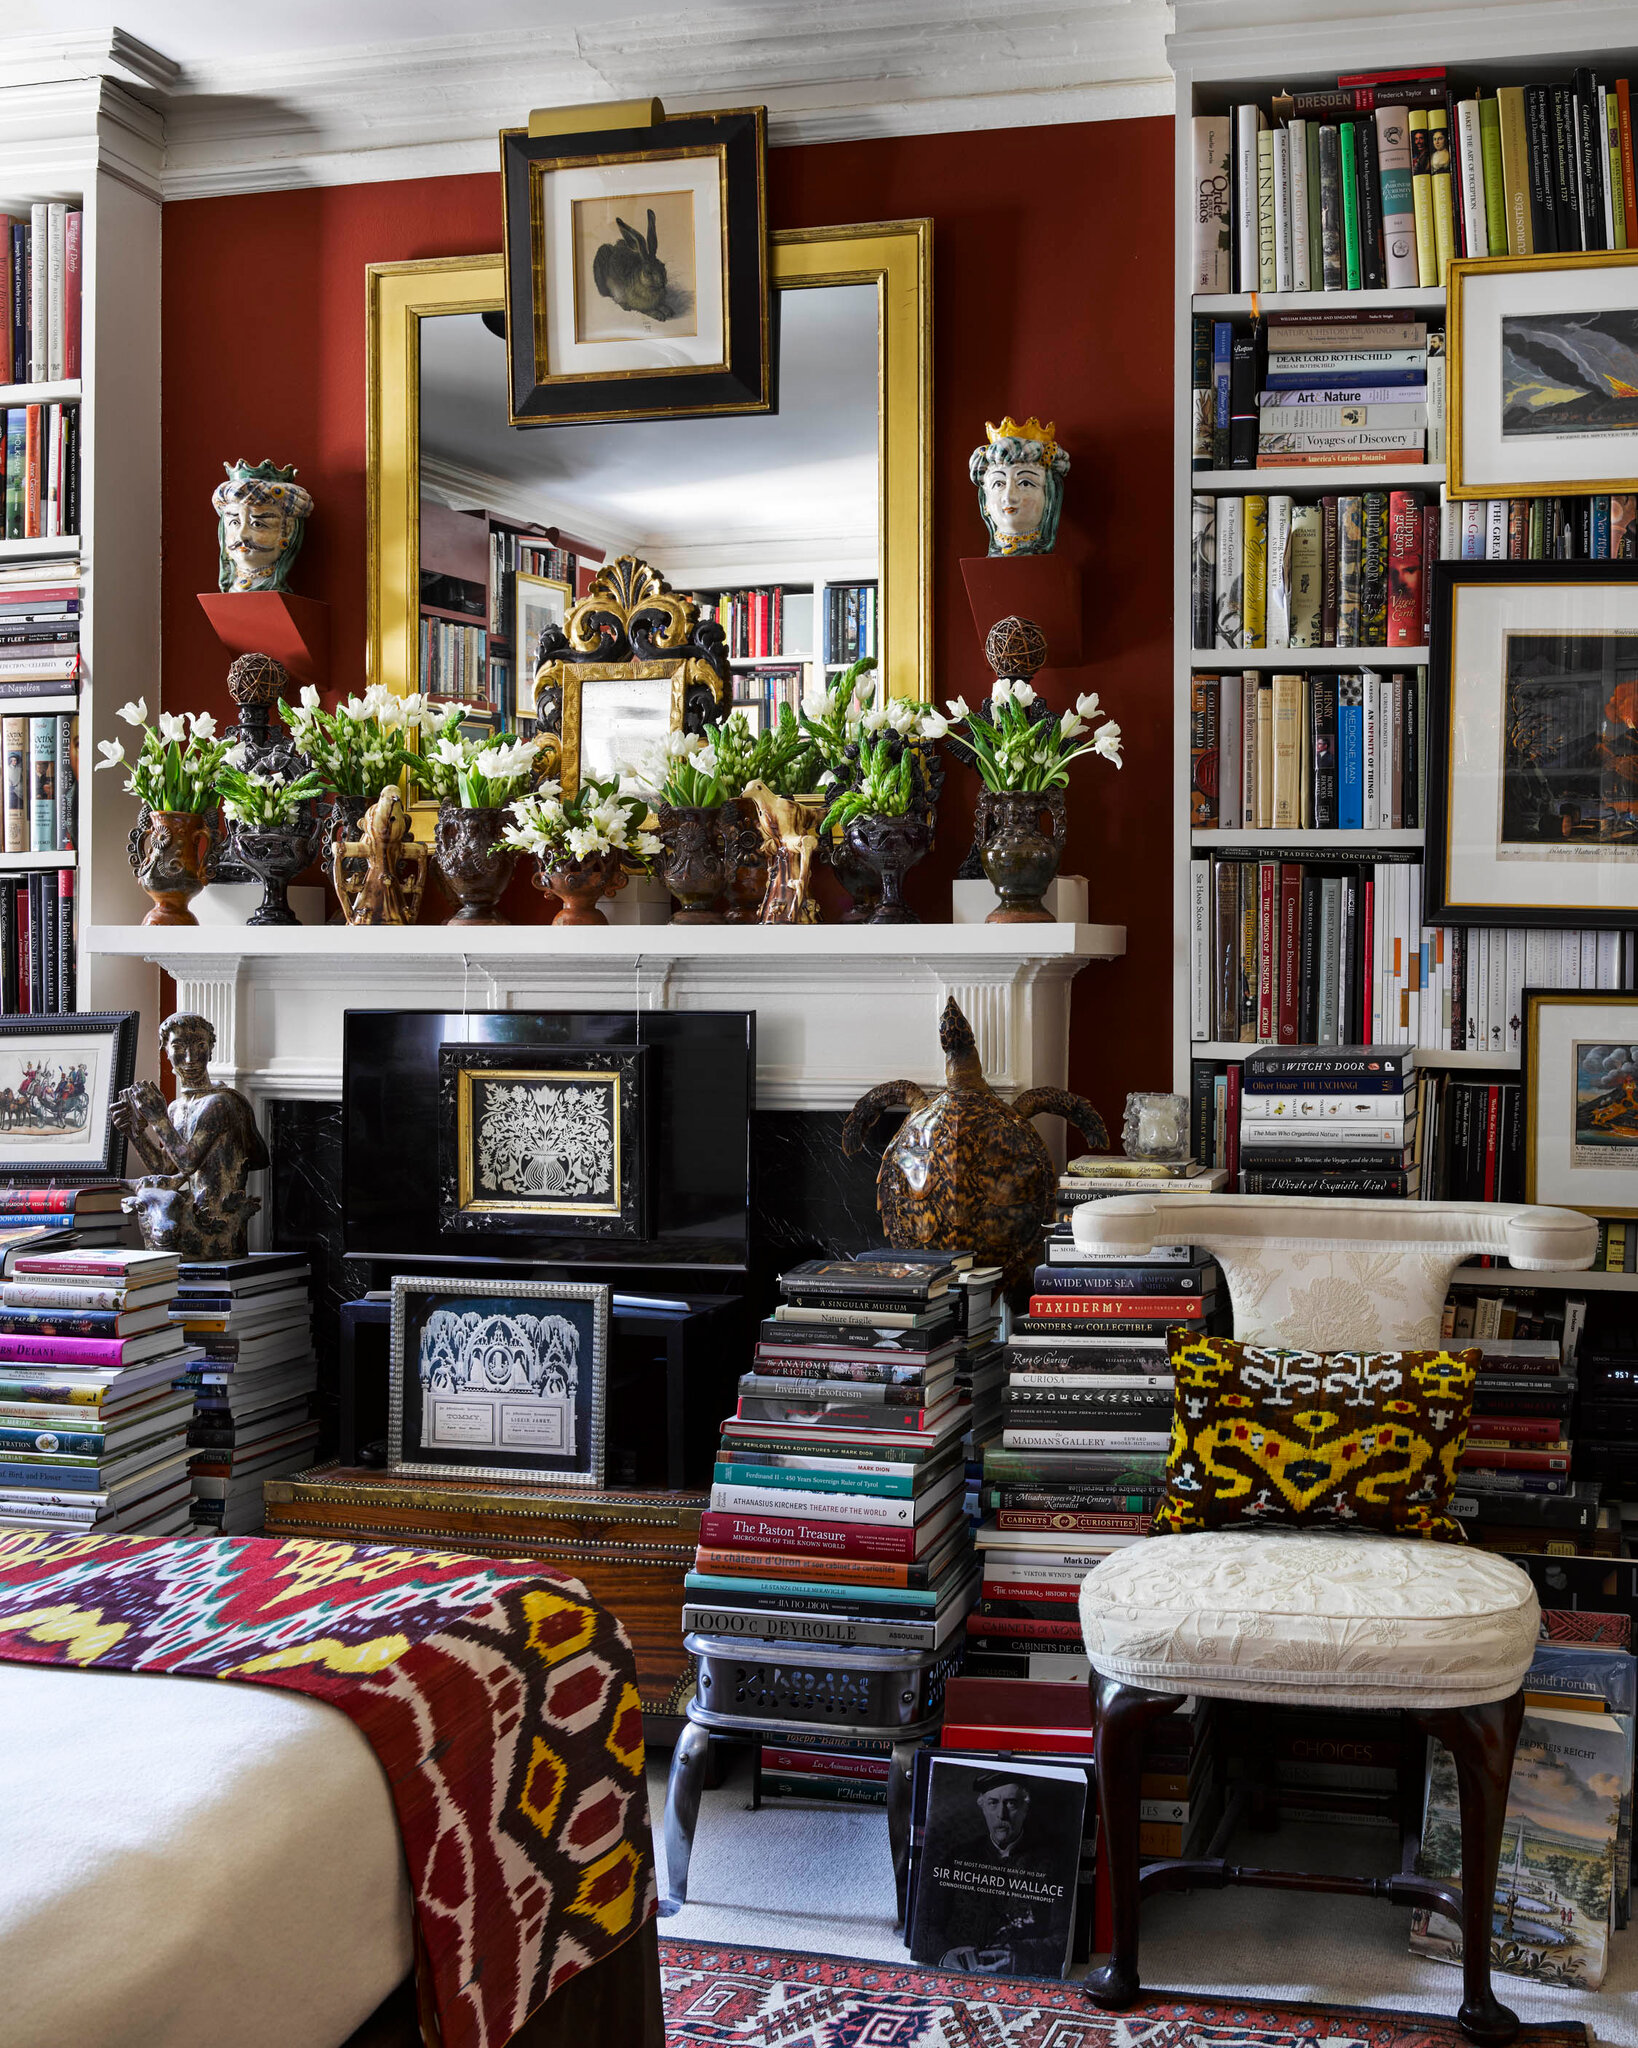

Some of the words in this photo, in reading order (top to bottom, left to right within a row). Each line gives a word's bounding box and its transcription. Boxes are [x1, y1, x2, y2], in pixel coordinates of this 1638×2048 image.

[1298, 94, 1351, 108] DRESDEN
[1378, 91, 1403, 99] Frederick
[1529, 105, 1538, 122] Royal
[1553, 104, 1562, 122] Royal
[1531, 123, 1539, 144] Danish
[1556, 123, 1564, 144] Danish
[1469, 164, 1475, 172] OF
[1533, 146, 1541, 186] Kunstkammer
[1558, 145, 1566, 185] Kunstkammer
[1200, 178, 1214, 223] Chaos
[1213, 176, 1228, 217] Order
[1259, 153, 1272, 266] LINNAEUS
[1331, 353, 1392, 361] ROTHSCHILD
[1307, 435, 1345, 447] Voyages
[1348, 434, 1357, 444] of
[1360, 433, 1407, 444] Discovery
[1328, 506, 1336, 524] THE
[1368, 498, 1380, 538] PHILIPPA
[1468, 503, 1480, 522] The
[1403, 499, 1414, 548] philippa
[1328, 525, 1336, 547] JOHN
[1394, 515, 1404, 560] gregory
[1467, 524, 1478, 555] Great
[1368, 542, 1380, 583] GREGORY
[1328, 549, 1336, 608] TRADESCANTS
[8, 683, 40, 695] Napoléon
[1196, 689, 1204, 707] THE
[1314, 682, 1323, 727] WELLCOME
[1207, 692, 1215, 749] COLLECTING
[1368, 710, 1374, 720] AN
[1196, 711, 1204, 747] WORLD
[1368, 758, 1374, 768] OF
[1245, 909, 1255, 973] Enlightenment
[1263, 943, 1269, 953] OF
[1054, 1279, 1082, 1288] WIDE
[1084, 1279, 1112, 1288] WIDE
[1115, 1279, 1134, 1288] SEA
[828, 1301, 869, 1309] SINGULAR
[872, 1302, 907, 1311] MUSEUM
[1036, 1303, 1123, 1313] TAXIDERMY
[821, 1315, 847, 1323] Nature
[848, 1315, 873, 1325] fragile
[1086, 1323, 1153, 1331] COLLECTIBLE
[17, 1345, 56, 1357] DELANY
[778, 1360, 828, 1370] ANATOMY
[783, 1367, 820, 1377] RICHES
[1023, 1376, 1065, 1384] CURIOSA
[775, 1383, 815, 1397] Inventing
[818, 1384, 862, 1399] Exoticism
[1012, 1392, 1154, 1402] WUNDERKAMMER
[1012, 1436, 1060, 1445] MADMAN'S
[1062, 1437, 1105, 1446] GALLERY
[40, 1472, 62, 1480] Flower
[734, 1498, 773, 1507] ATHANASIUS
[774, 1502, 807, 1510] KIRCHER'S
[810, 1504, 839, 1512] THEATRE
[864, 1508, 887, 1517] WORLD
[42, 1509, 65, 1517] Creators
[733, 1520, 755, 1533] The
[759, 1522, 794, 1537] Paston
[798, 1526, 846, 1541] Treasure
[733, 1535, 771, 1543] MICROCOSM
[823, 1541, 845, 1549] WORLD
[889, 1632, 925, 1641] ASSOULINE
[1560, 1677, 1596, 1690] Forum
[1292, 1740, 1373, 1762] CHOICES
[1520, 1740, 1561, 1753] ERDKREIS
[1564, 1747, 1596, 1760] REICHT
[812, 1760, 824, 1768] Les
[933, 1867, 950, 1879] SIR
[953, 1870, 1006, 1888] RICHARD
[1008, 1878, 1064, 1897] WALLACE
